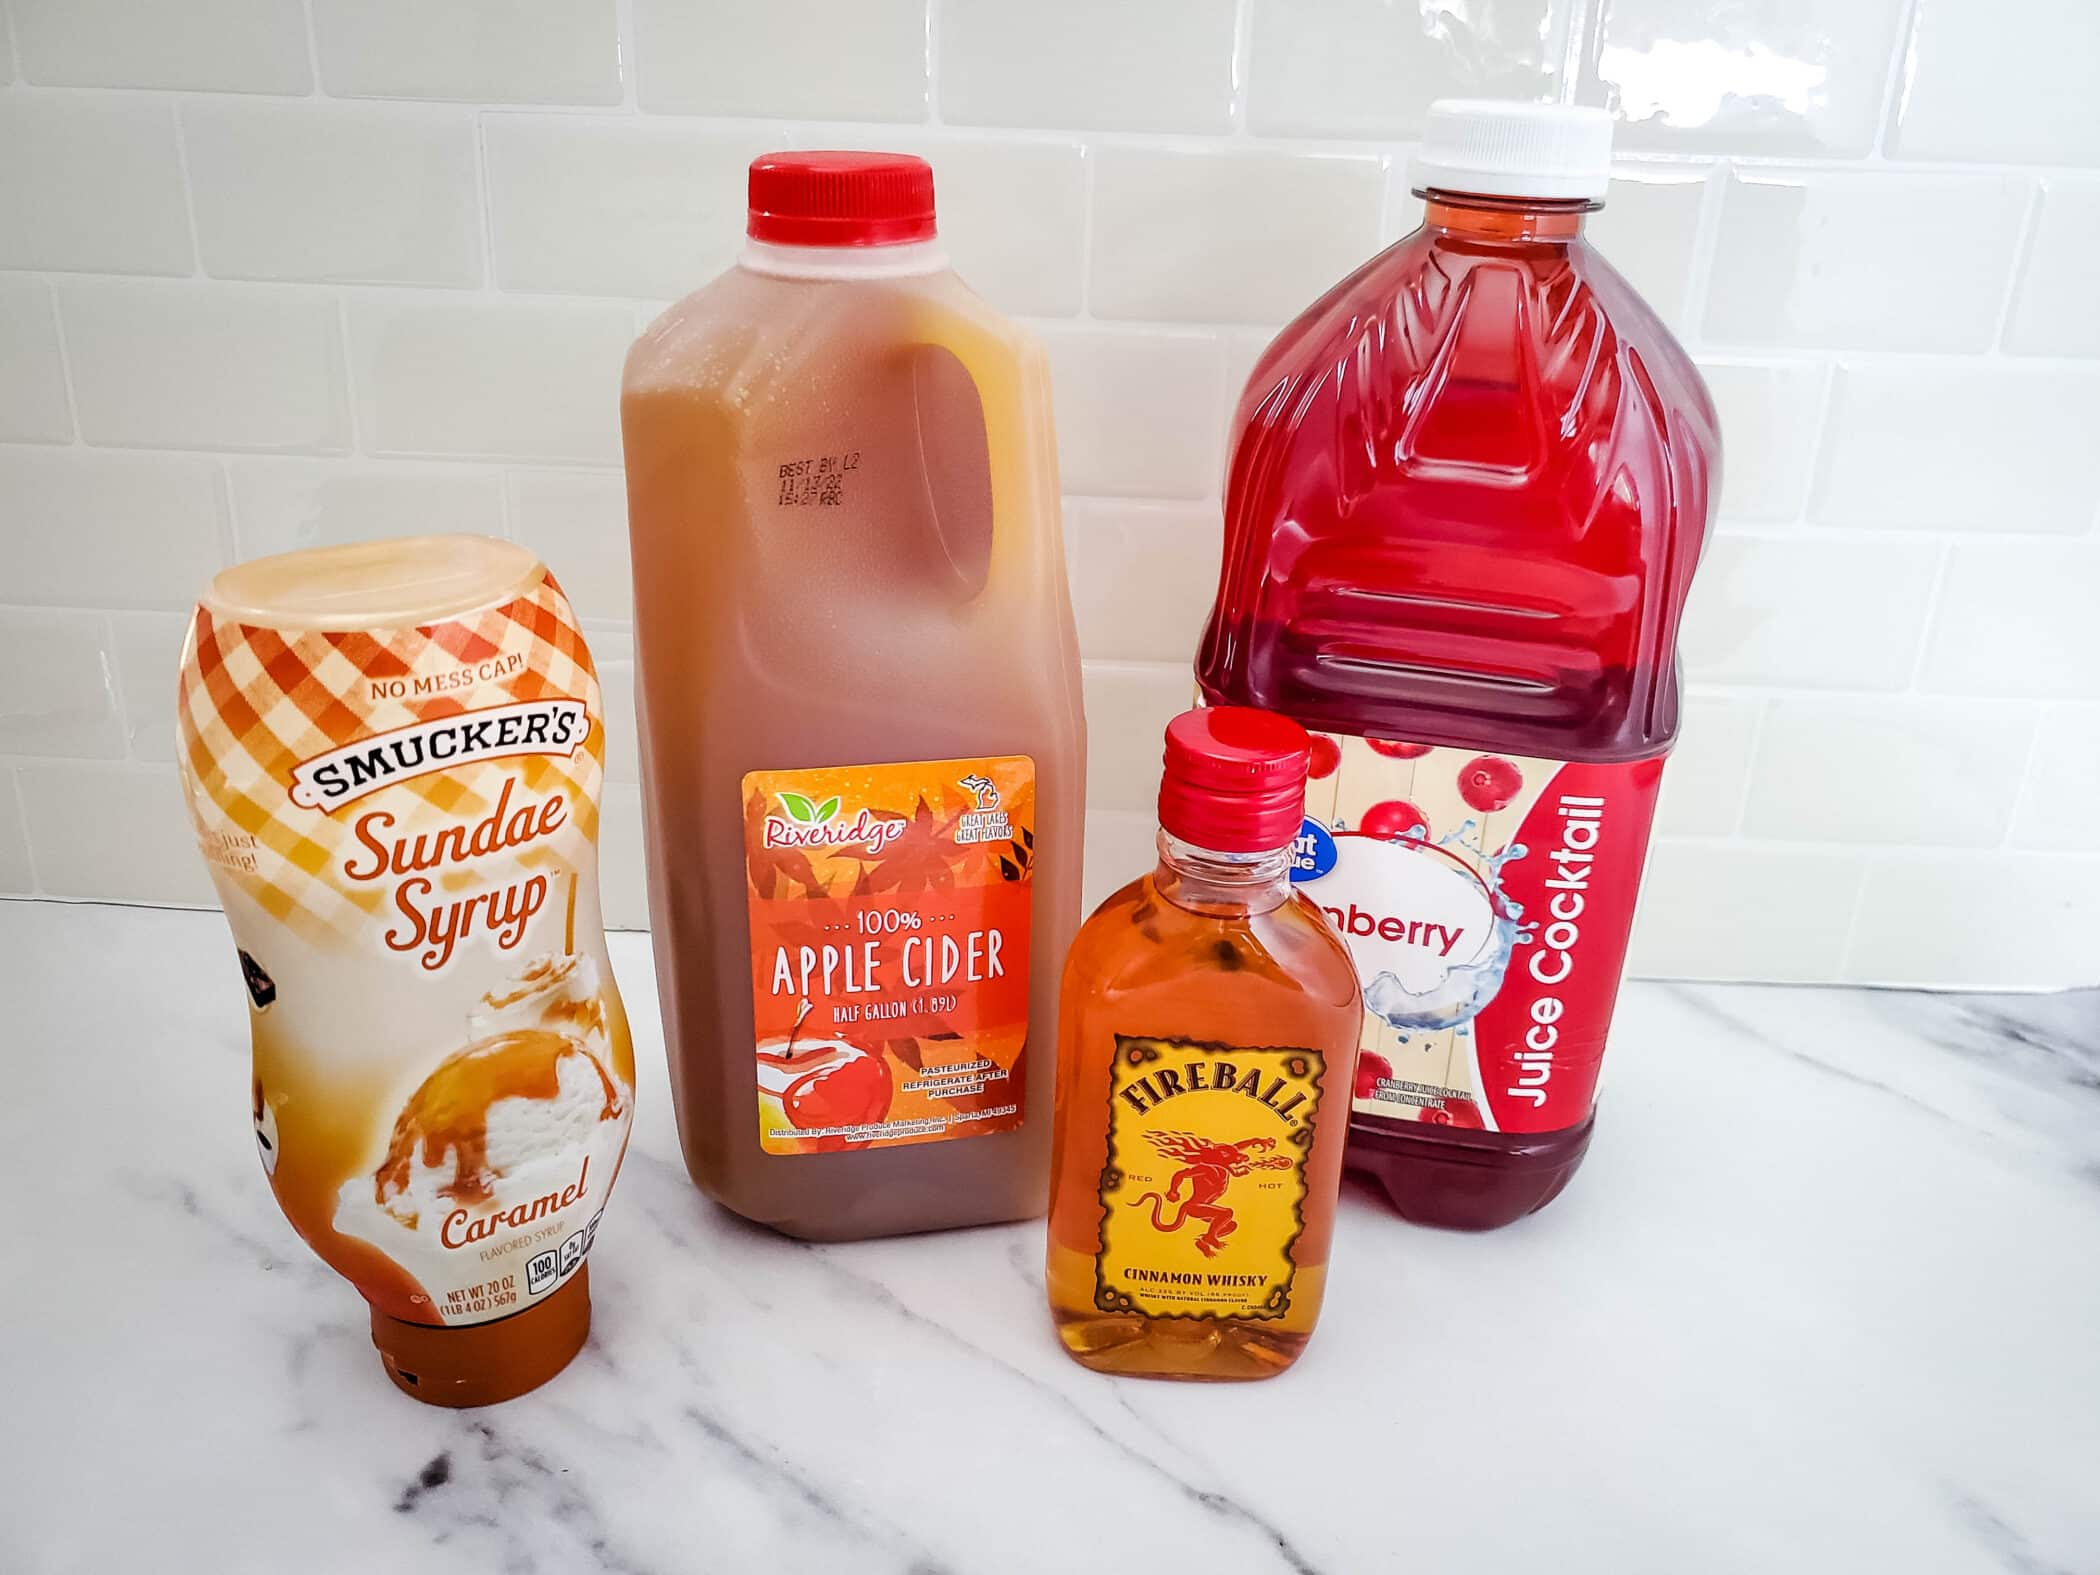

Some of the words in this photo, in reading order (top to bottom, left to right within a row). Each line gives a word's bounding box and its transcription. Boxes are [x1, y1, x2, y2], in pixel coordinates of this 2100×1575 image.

[779, 460, 814, 478] BEST
[819, 457, 838, 473] BY
[843, 452, 860, 470] L2
[371, 681, 406, 699] NO
[413, 668, 474, 696] MESS
[479, 652, 524, 681] CAP!
[313, 707, 577, 798] SMUCKER'S
[344, 777, 569, 881] Sundae
[766, 808, 902, 851] Riveridge
[961, 815, 984, 828] GREAT
[982, 825, 1012, 840] FLAVORS
[1528, 795, 1605, 985] Cocktail
[384, 873, 548, 971] Syrup
[857, 908, 922, 935] 100%
[1322, 903, 1465, 957] nberry
[772, 941, 881, 997] APPLE
[902, 929, 1005, 988] CIDER
[833, 1005, 860, 1023] HALF
[865, 1001, 907, 1020] GALLON
[1506, 996, 1565, 1108] Juice
[903, 1076, 974, 1090] REFRIGERATE
[975, 1069, 1008, 1081] AFTER
[921, 1060, 991, 1075] PASTEURIZED
[928, 1084, 984, 1098] PURCHASE
[1119, 1061, 1309, 1124] FIREBALL
[1375, 1089, 1397, 1102] FROM
[1397, 1093, 1446, 1110] CONCENTRATE
[1376, 1077, 1417, 1093] CRANBERRY
[1418, 1083, 1437, 1097] JUICE
[1439, 1087, 1472, 1101] COCKTAIL
[769, 1128, 809, 1137] Distributed
[825, 1125, 860, 1136] Riveridge
[861, 1122, 891, 1132] Produce
[1128, 1174, 1153, 1182] RED
[440, 1156, 590, 1250] Caramel
[479, 1235, 533, 1262] FLAVORED
[535, 1220, 566, 1243] SYRUP
[530, 1268, 556, 1286] CALORIES
[533, 1256, 552, 1276] 100
[1123, 1267, 1202, 1286] CINNAMON
[1207, 1274, 1268, 1287] WHISKY
[447, 1289, 467, 1304] NET
[468, 1284, 486, 1299] WT
[488, 1280, 500, 1295] 20
[502, 1275, 517, 1290] OZ
[494, 1291, 517, 1309] 567g
